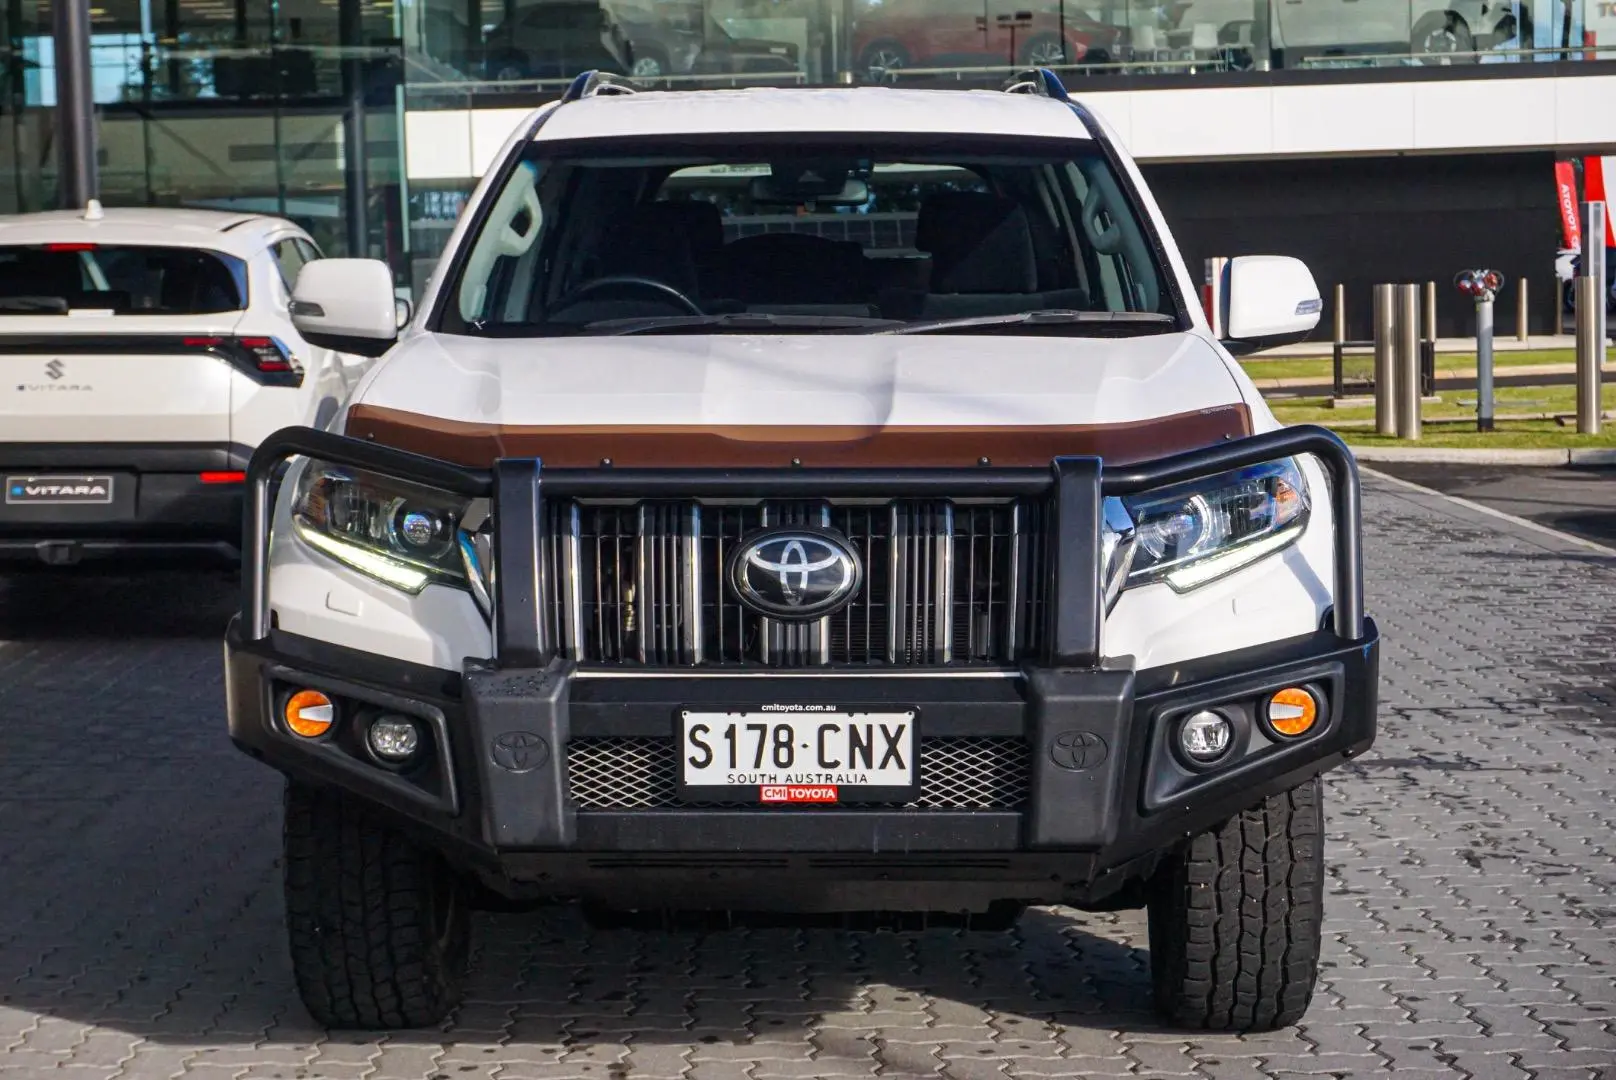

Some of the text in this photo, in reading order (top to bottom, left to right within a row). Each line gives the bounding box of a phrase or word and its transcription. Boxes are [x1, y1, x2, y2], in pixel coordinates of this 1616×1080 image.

[761, 703, 837, 713] cmitoyota.com.au
[727, 773, 868, 784] SOUTH AUSTRALIA
[764, 788, 836, 798] CMI TOYOTA
